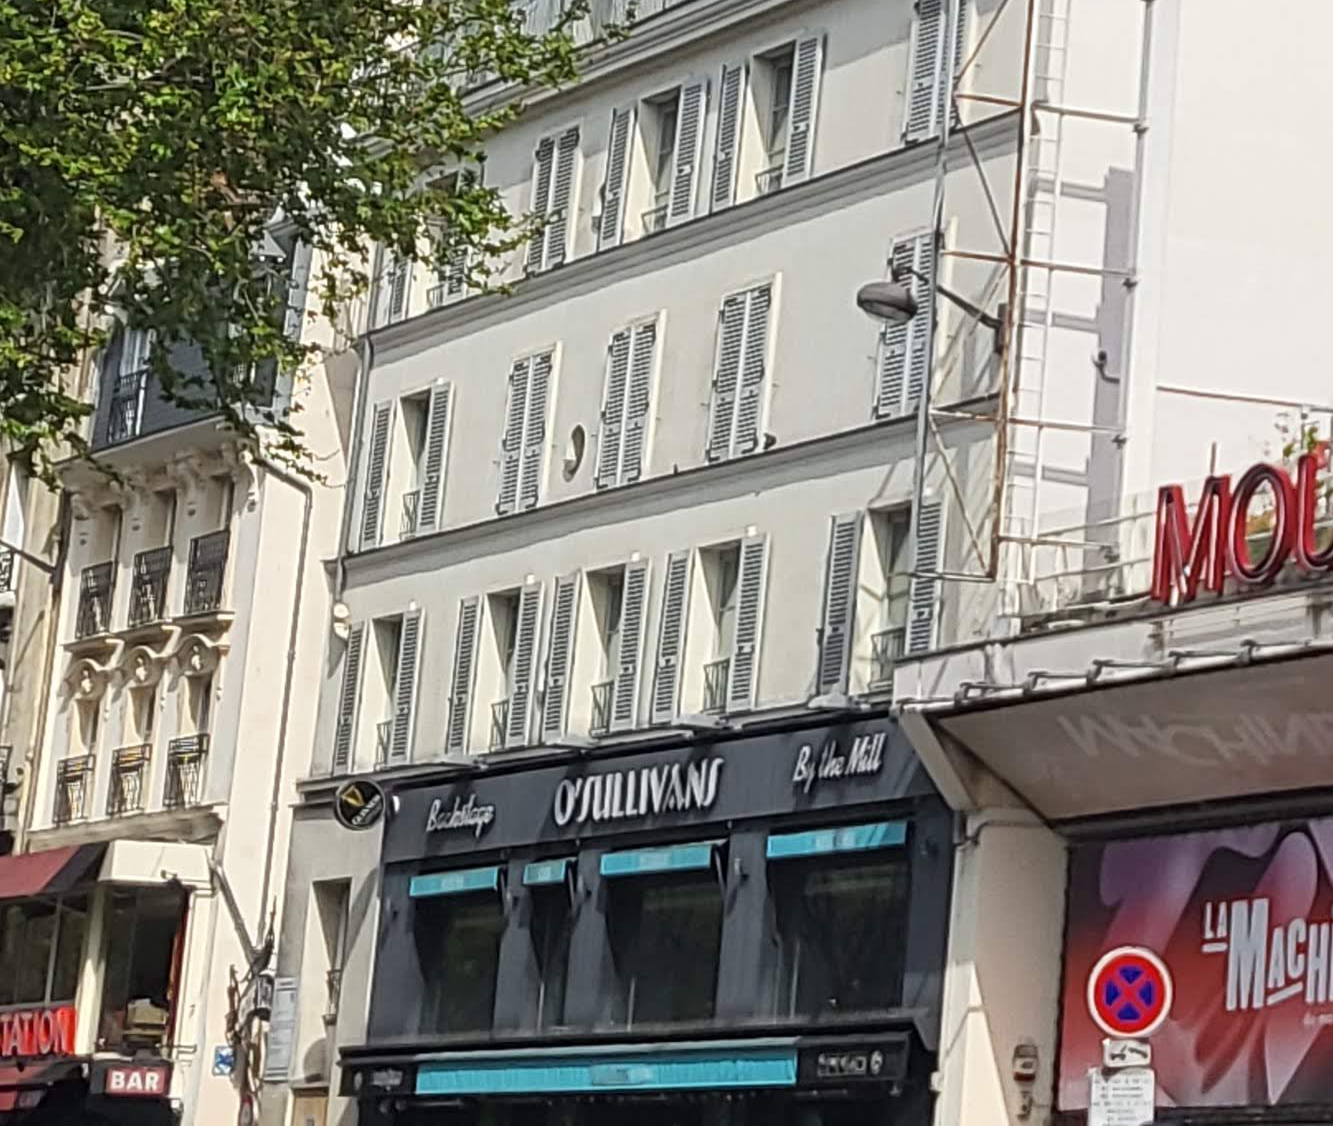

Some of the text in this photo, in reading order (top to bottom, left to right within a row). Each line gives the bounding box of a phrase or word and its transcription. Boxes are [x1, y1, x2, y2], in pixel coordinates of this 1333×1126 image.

[792, 732, 888, 793] By the Mill
[554, 757, 725, 826] O'SULLIVANS
[1203, 900, 1228, 940] LA
[110, 1071, 162, 1092] BAR
